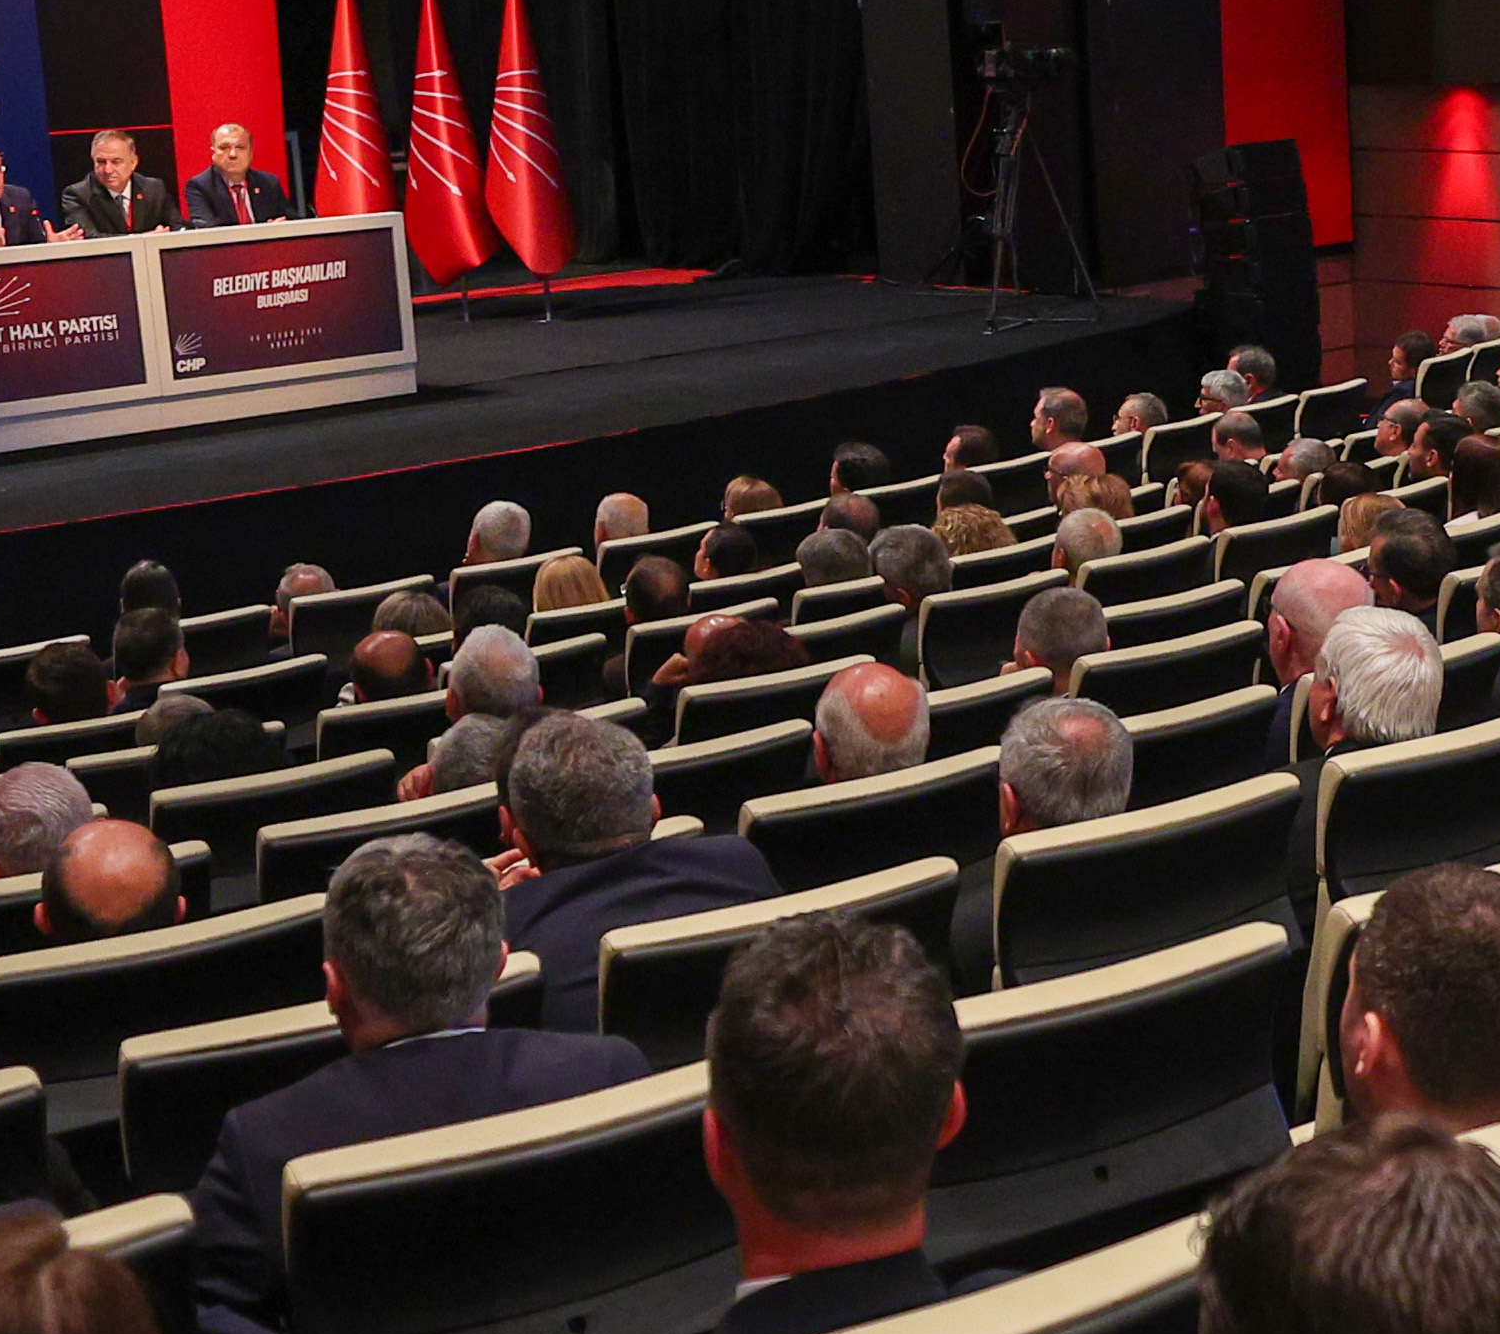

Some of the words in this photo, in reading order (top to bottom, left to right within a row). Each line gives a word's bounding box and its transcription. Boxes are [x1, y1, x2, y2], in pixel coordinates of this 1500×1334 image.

[213, 271, 270, 297] BELEDİYE
[271, 260, 347, 289] BAŞKANLARI
[9, 321, 55, 341] HALK
[58, 314, 118, 336] PARTİSİ
[176, 357, 207, 373] CHP
